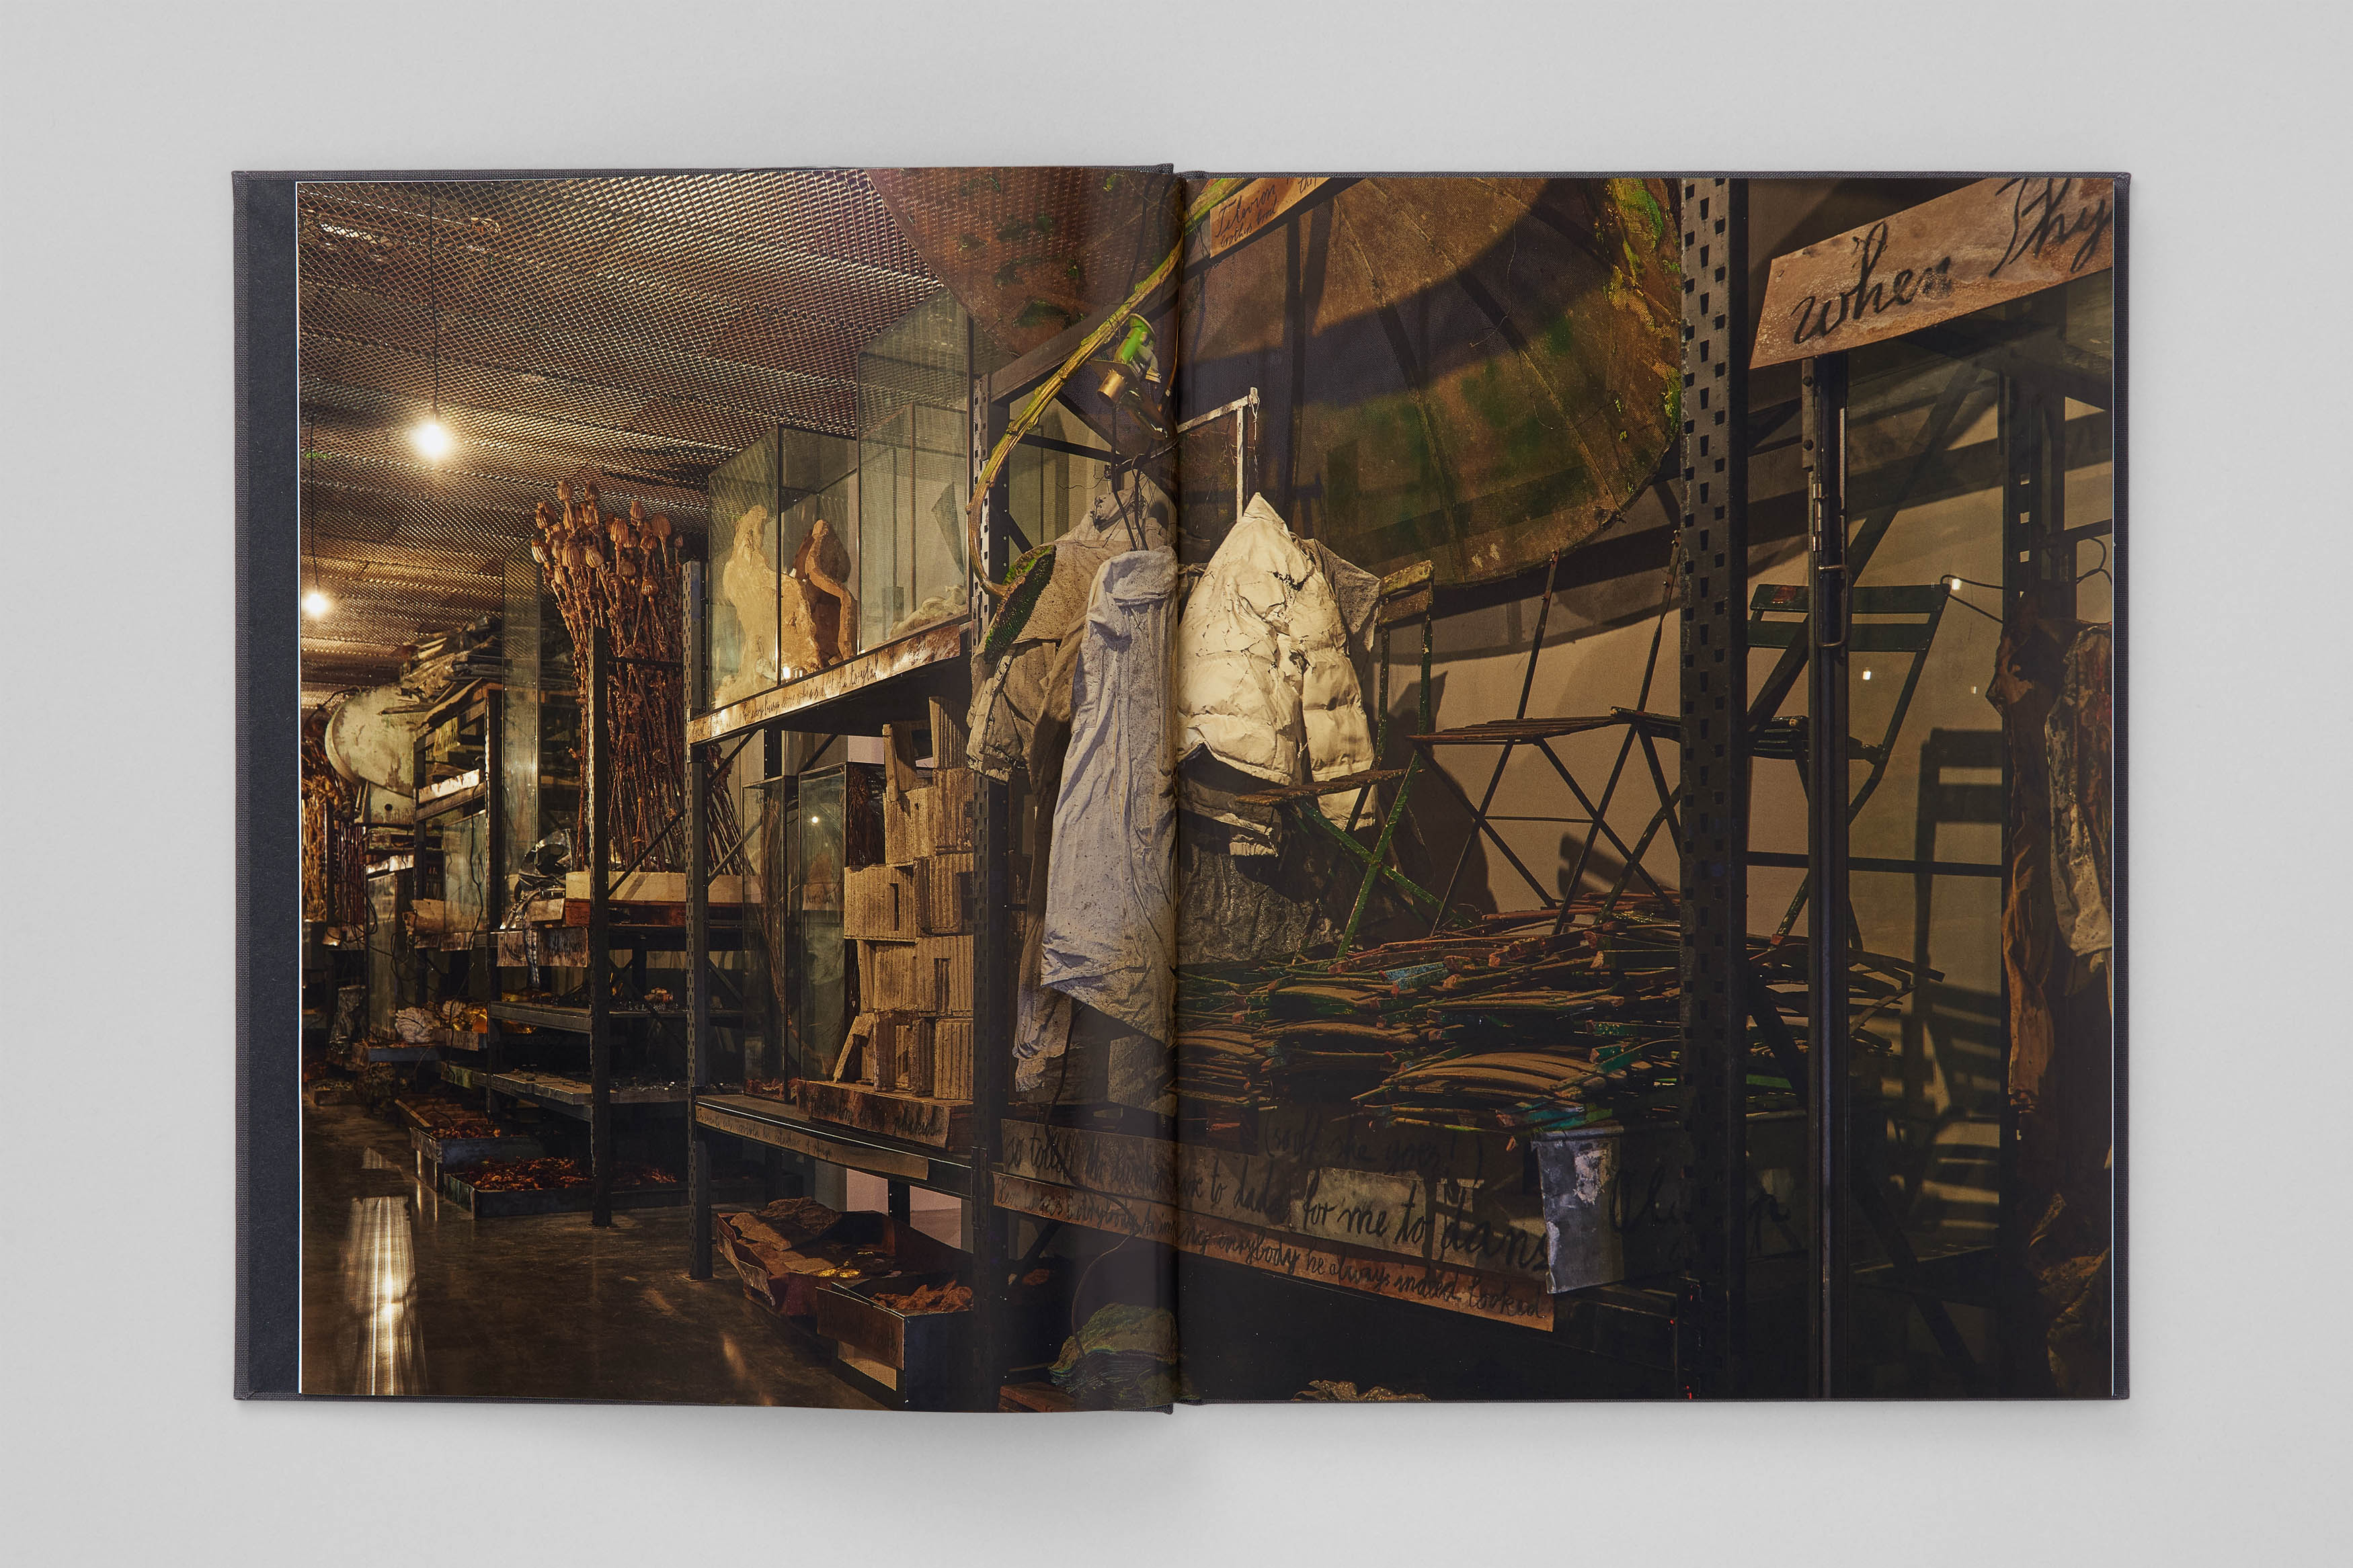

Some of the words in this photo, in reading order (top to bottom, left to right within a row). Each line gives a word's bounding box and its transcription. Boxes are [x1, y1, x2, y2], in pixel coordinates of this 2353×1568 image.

[1790, 221, 1954, 345] when
[1302, 1166, 1337, 1231] for
[1337, 1205, 1388, 1238] me
[1393, 1180, 1427, 1245] to
[1306, 1240, 1327, 1276] he
